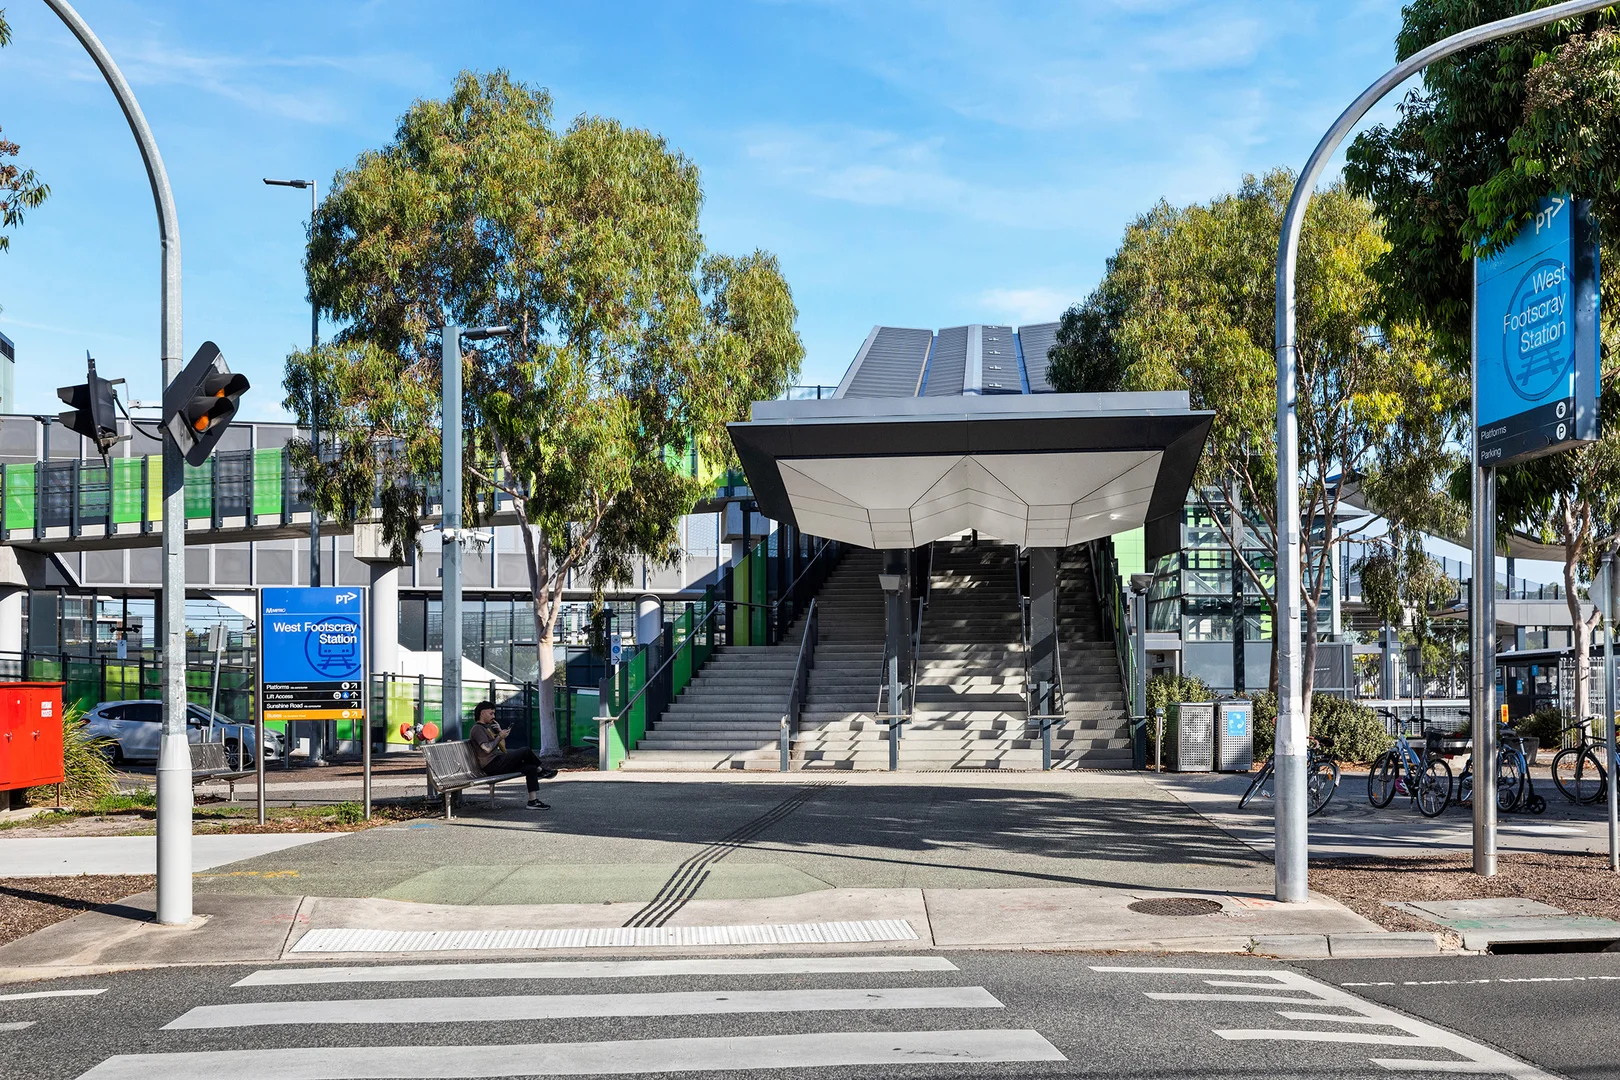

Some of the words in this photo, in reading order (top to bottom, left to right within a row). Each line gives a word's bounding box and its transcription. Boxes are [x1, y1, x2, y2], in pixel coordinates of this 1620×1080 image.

[1532, 263, 1567, 295] West
[1503, 292, 1567, 335] Footscray
[1520, 319, 1566, 354] Station
[1480, 425, 1507, 441] Platforms
[1480, 446, 1502, 461] Parking
[273, 622, 301, 633] West
[304, 622, 357, 635] Footscray
[319, 634, 357, 644] Station
